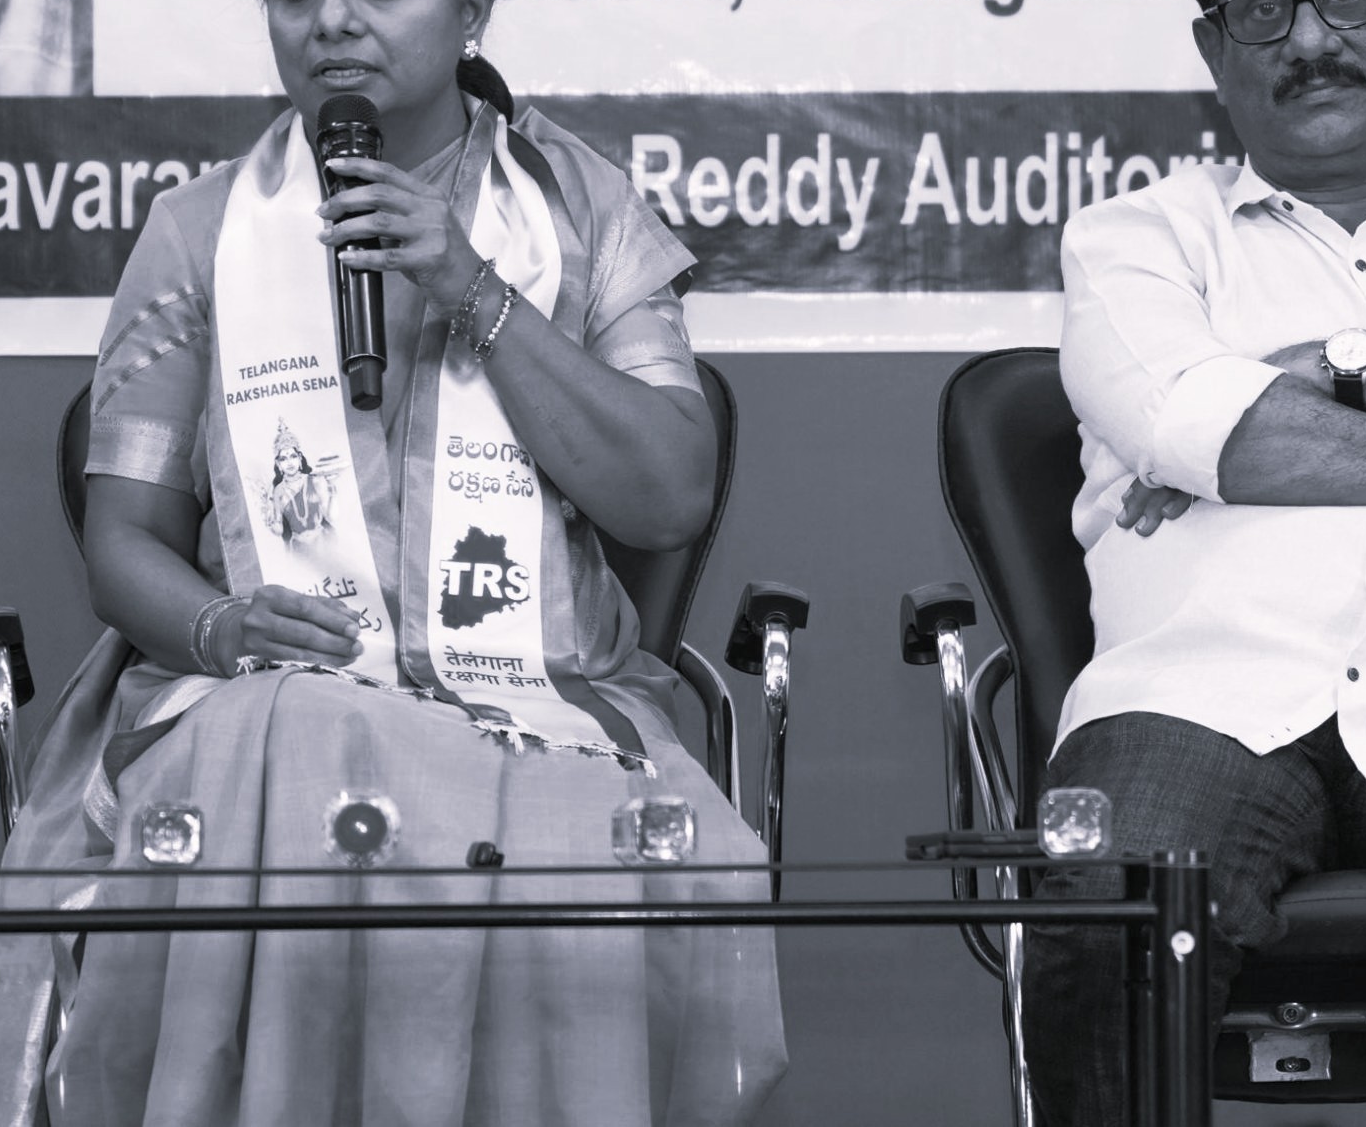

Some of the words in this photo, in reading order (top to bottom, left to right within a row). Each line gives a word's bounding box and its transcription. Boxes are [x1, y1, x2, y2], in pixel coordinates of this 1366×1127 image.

[631, 132, 881, 252] Reddy
[239, 355, 320, 380] TELANGANA
[226, 380, 300, 406] RAKSHANA
[302, 375, 339, 392] SENA
[440, 559, 531, 601] TRS
[443, 644, 524, 673] तेलंगाना
[441, 670, 500, 686] रक्षणा
[504, 672, 547, 688] सेना
